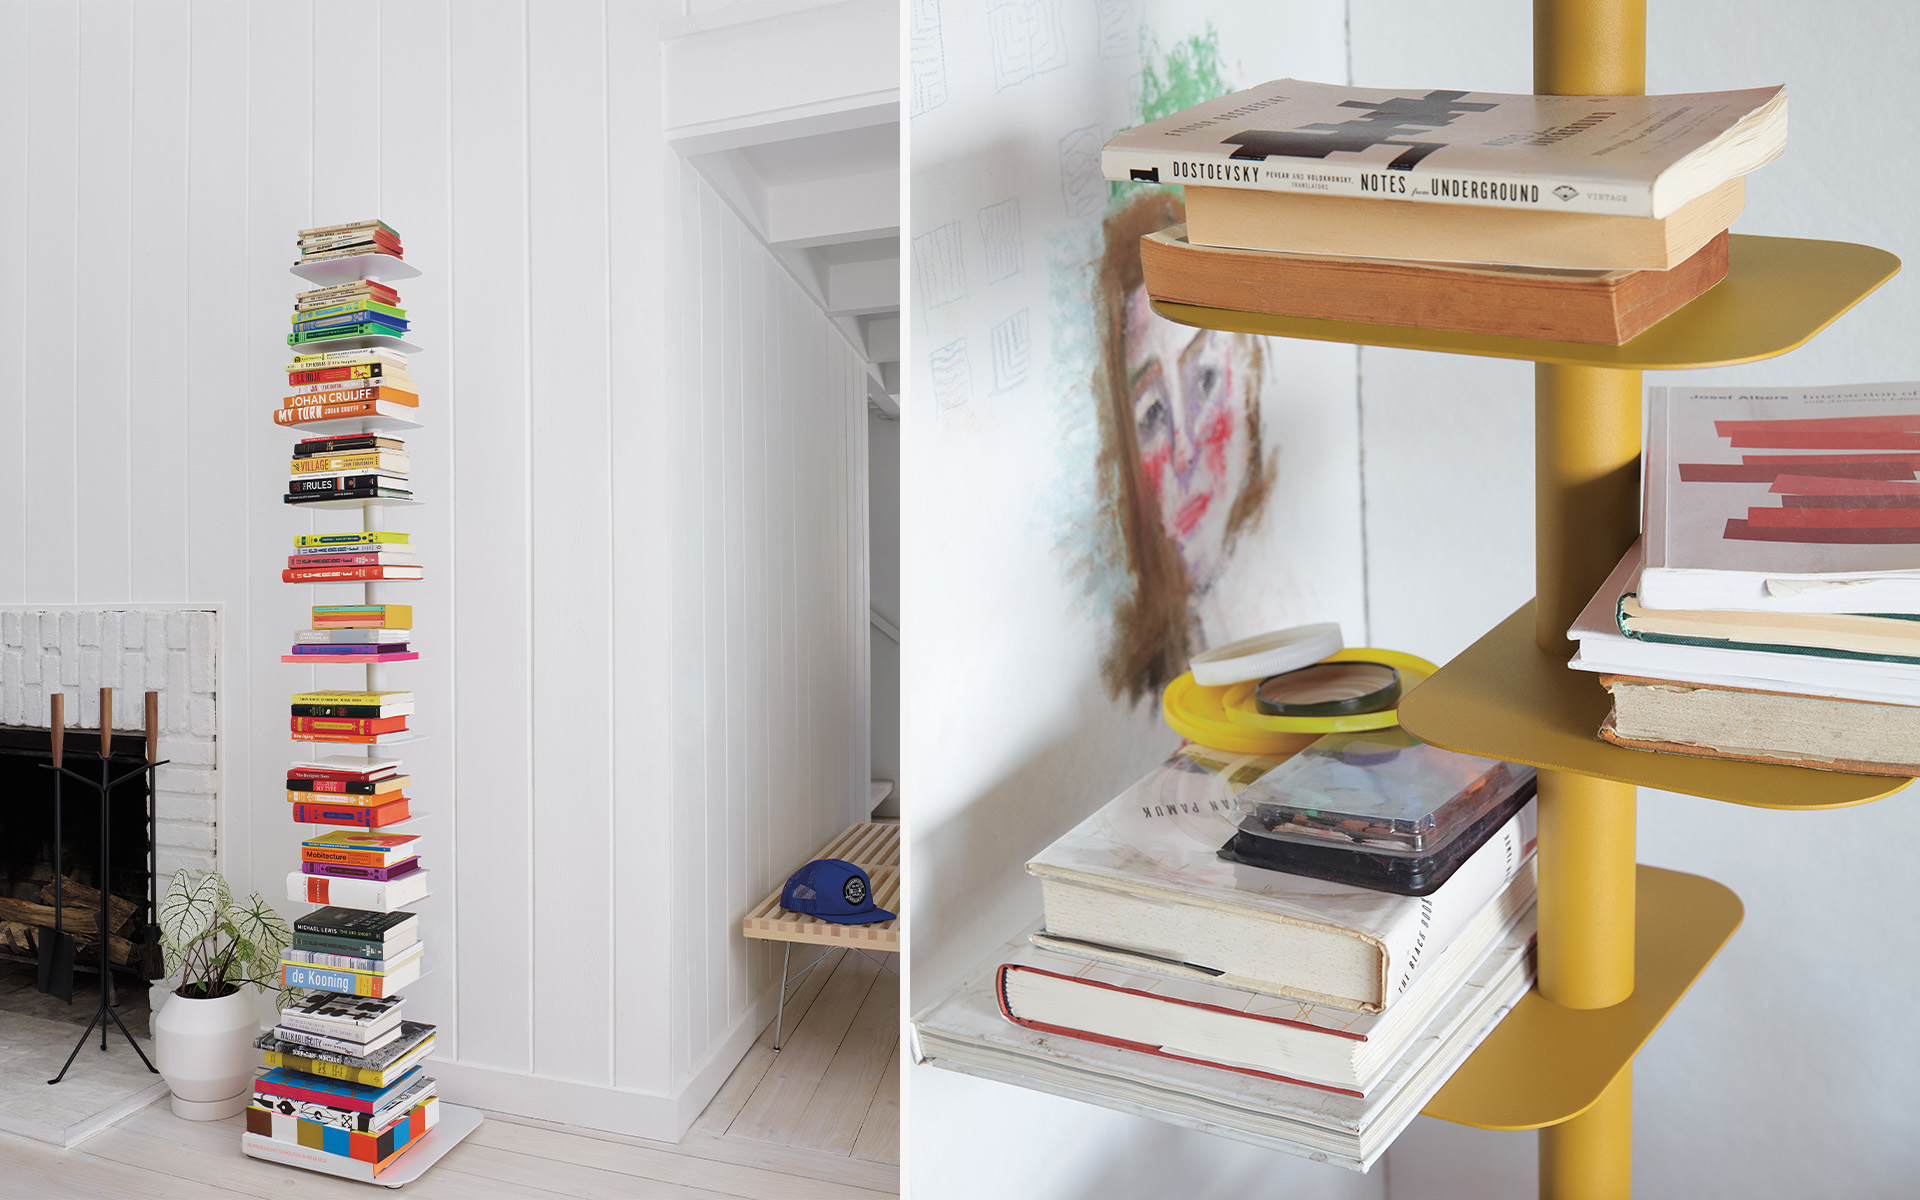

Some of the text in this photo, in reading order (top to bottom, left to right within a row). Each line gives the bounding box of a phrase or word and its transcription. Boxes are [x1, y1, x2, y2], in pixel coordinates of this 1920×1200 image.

[1164, 96, 1291, 136] FYODOR DOSTOEVSKY
[1173, 161, 1259, 182] DOSTOEVSKY
[1266, 171, 1290, 180] PEVEAR
[1292, 172, 1305, 180] AND
[1291, 182, 1328, 190] TRANSLATORS
[1361, 173, 1628, 204] NOTES from UNDERGROUND VINTAGE
[290, 388, 372, 407] JOHAN CRUIJFF
[278, 409, 293, 422] MY
[298, 406, 322, 420] TURN
[341, 405, 360, 413] CRUYFF
[301, 459, 329, 472] VILLAGE
[306, 480, 332, 490] RULES
[1142, 802, 1200, 818] PAMUK
[306, 851, 347, 860] Mobitecture
[1398, 897, 1432, 994] THE BLACK BOOK
[292, 969, 349, 993] de Kooning
[281, 1031, 308, 1045] WALKABLE
[310, 1037, 322, 1047] CITY
